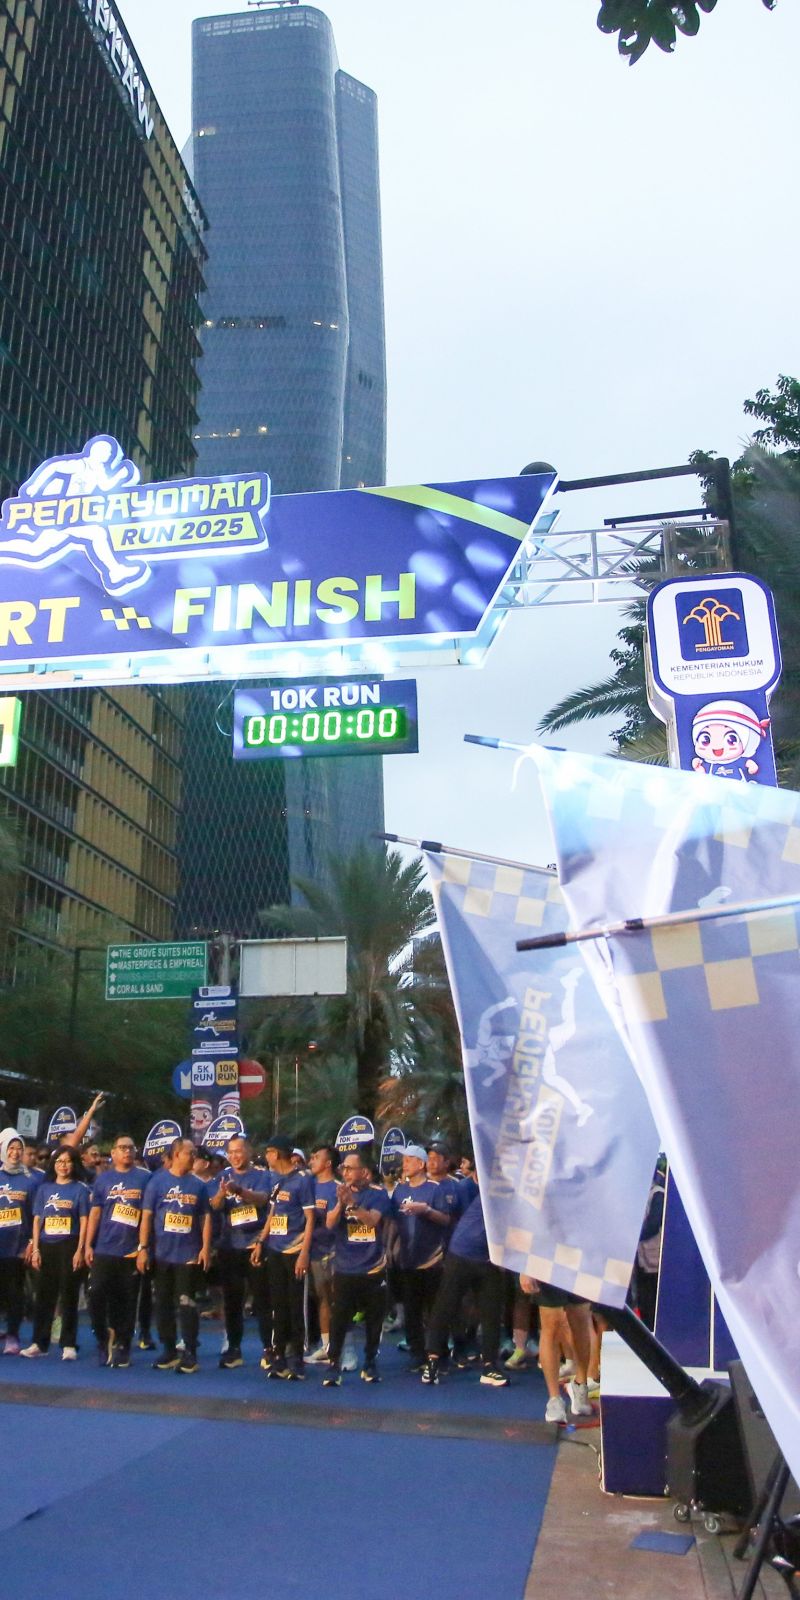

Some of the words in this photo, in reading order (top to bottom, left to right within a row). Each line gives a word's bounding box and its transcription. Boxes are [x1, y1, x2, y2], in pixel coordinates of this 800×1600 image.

[6, 478, 262, 529] PENGAYOMAN
[121, 524, 175, 545] RUN
[180, 517, 244, 540] 2025
[172, 572, 416, 634] FINISH
[670, 662, 731, 672] KEMENTERIAN
[733, 659, 764, 667] HUKUM
[673, 672, 715, 680] REPUBLIK
[716, 668, 763, 677] INDONESIA
[271, 688, 318, 710] 10K
[324, 684, 380, 707] RUN
[247, 709, 397, 745] 00:00:00
[119, 949, 131, 958] THE
[134, 948, 156, 958] GROVE
[158, 947, 181, 957] SUITES
[182, 946, 204, 956] HOTEL
[117, 960, 161, 969] MASTERPIECE
[170, 959, 204, 968] EMPYREAL
[116, 985, 139, 993] CORAL
[146, 984, 163, 993] SAND
[220, 1064, 234, 1072] 10K
[194, 1073, 213, 1081] RUN
[218, 1073, 237, 1081] RUN
